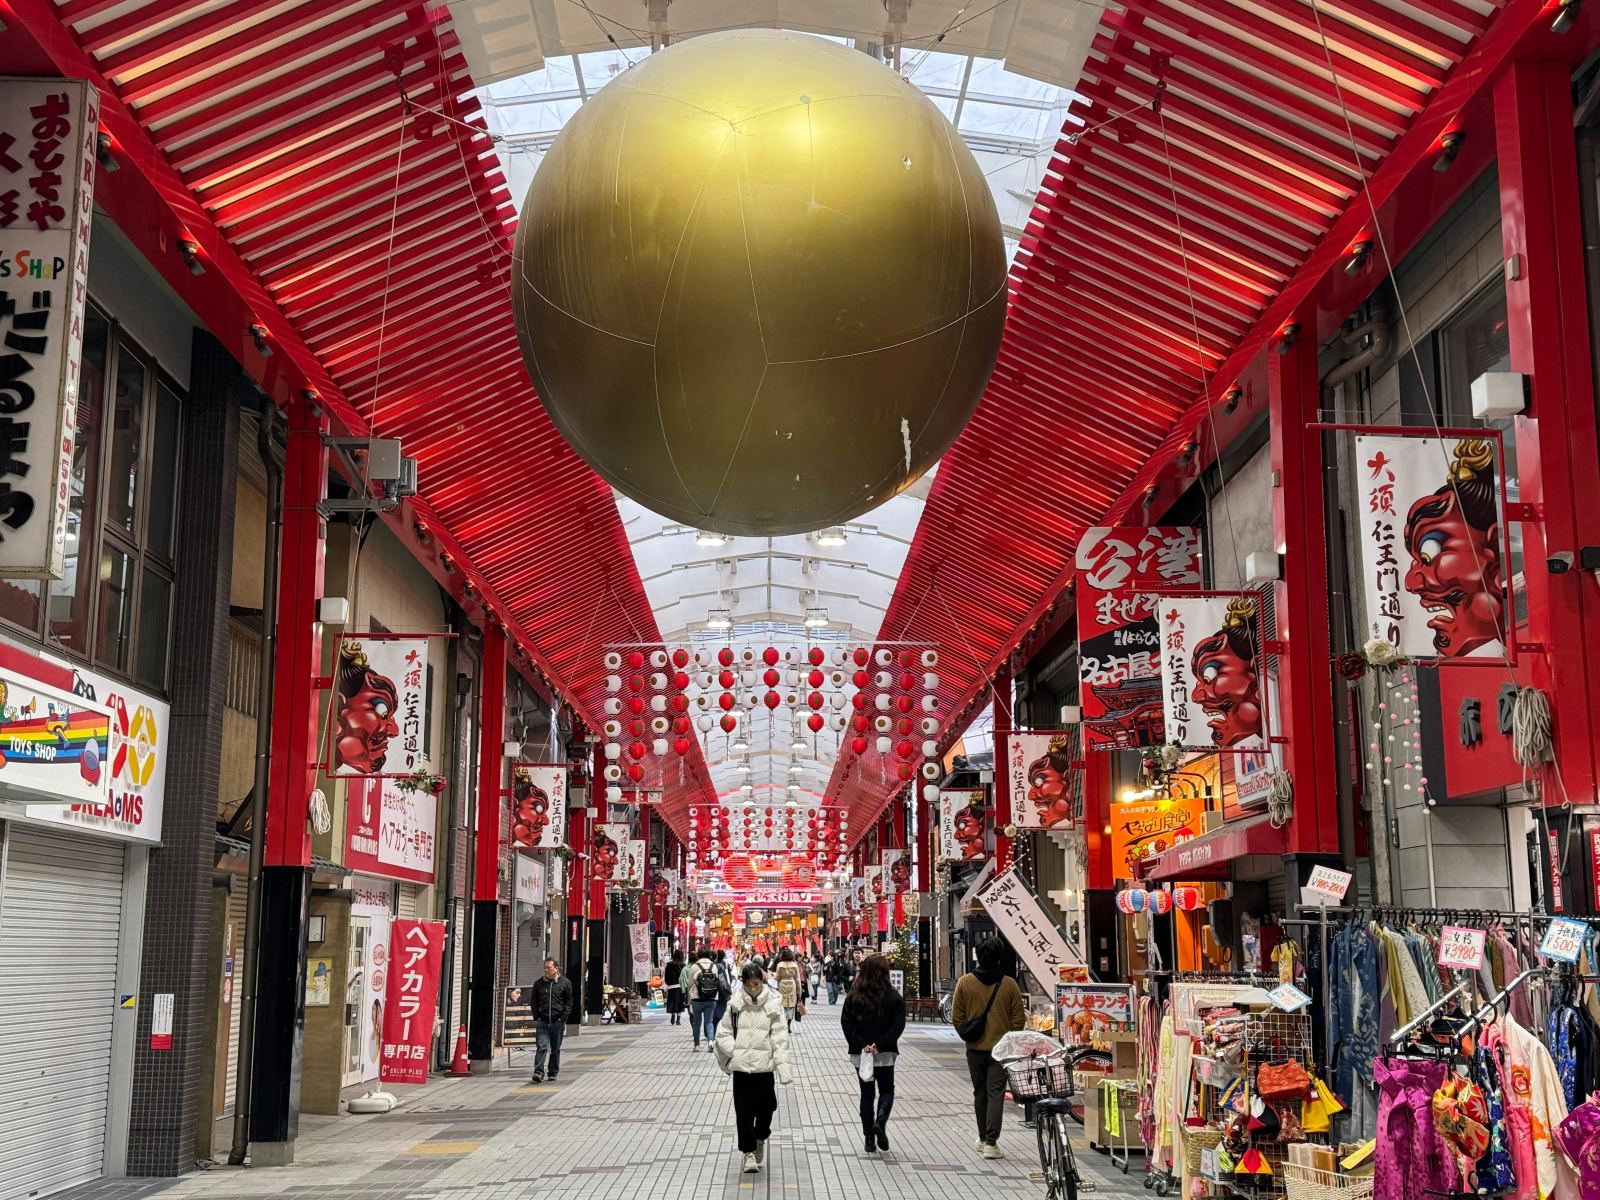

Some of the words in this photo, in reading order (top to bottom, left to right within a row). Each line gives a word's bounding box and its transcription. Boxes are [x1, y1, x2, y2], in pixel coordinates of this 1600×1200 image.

[71, 103, 97, 341] DARUMAYA
[1075, 526, 1200, 591] 台湾
[1367, 451, 1405, 648] 大須仁王門通り
[403, 649, 423, 769] 大須仁王門通り
[1165, 608, 1191, 742] 大須仁王門通り
[9, 736, 32, 756] TOYS
[34, 743, 57, 762] SHOP
[1012, 741, 1026, 825] 大須仁王門通り
[552, 773, 563, 845] 大須仁王門通り
[399, 925, 430, 1041] ヘアカラー
[383, 1043, 426, 1060] 専門店
